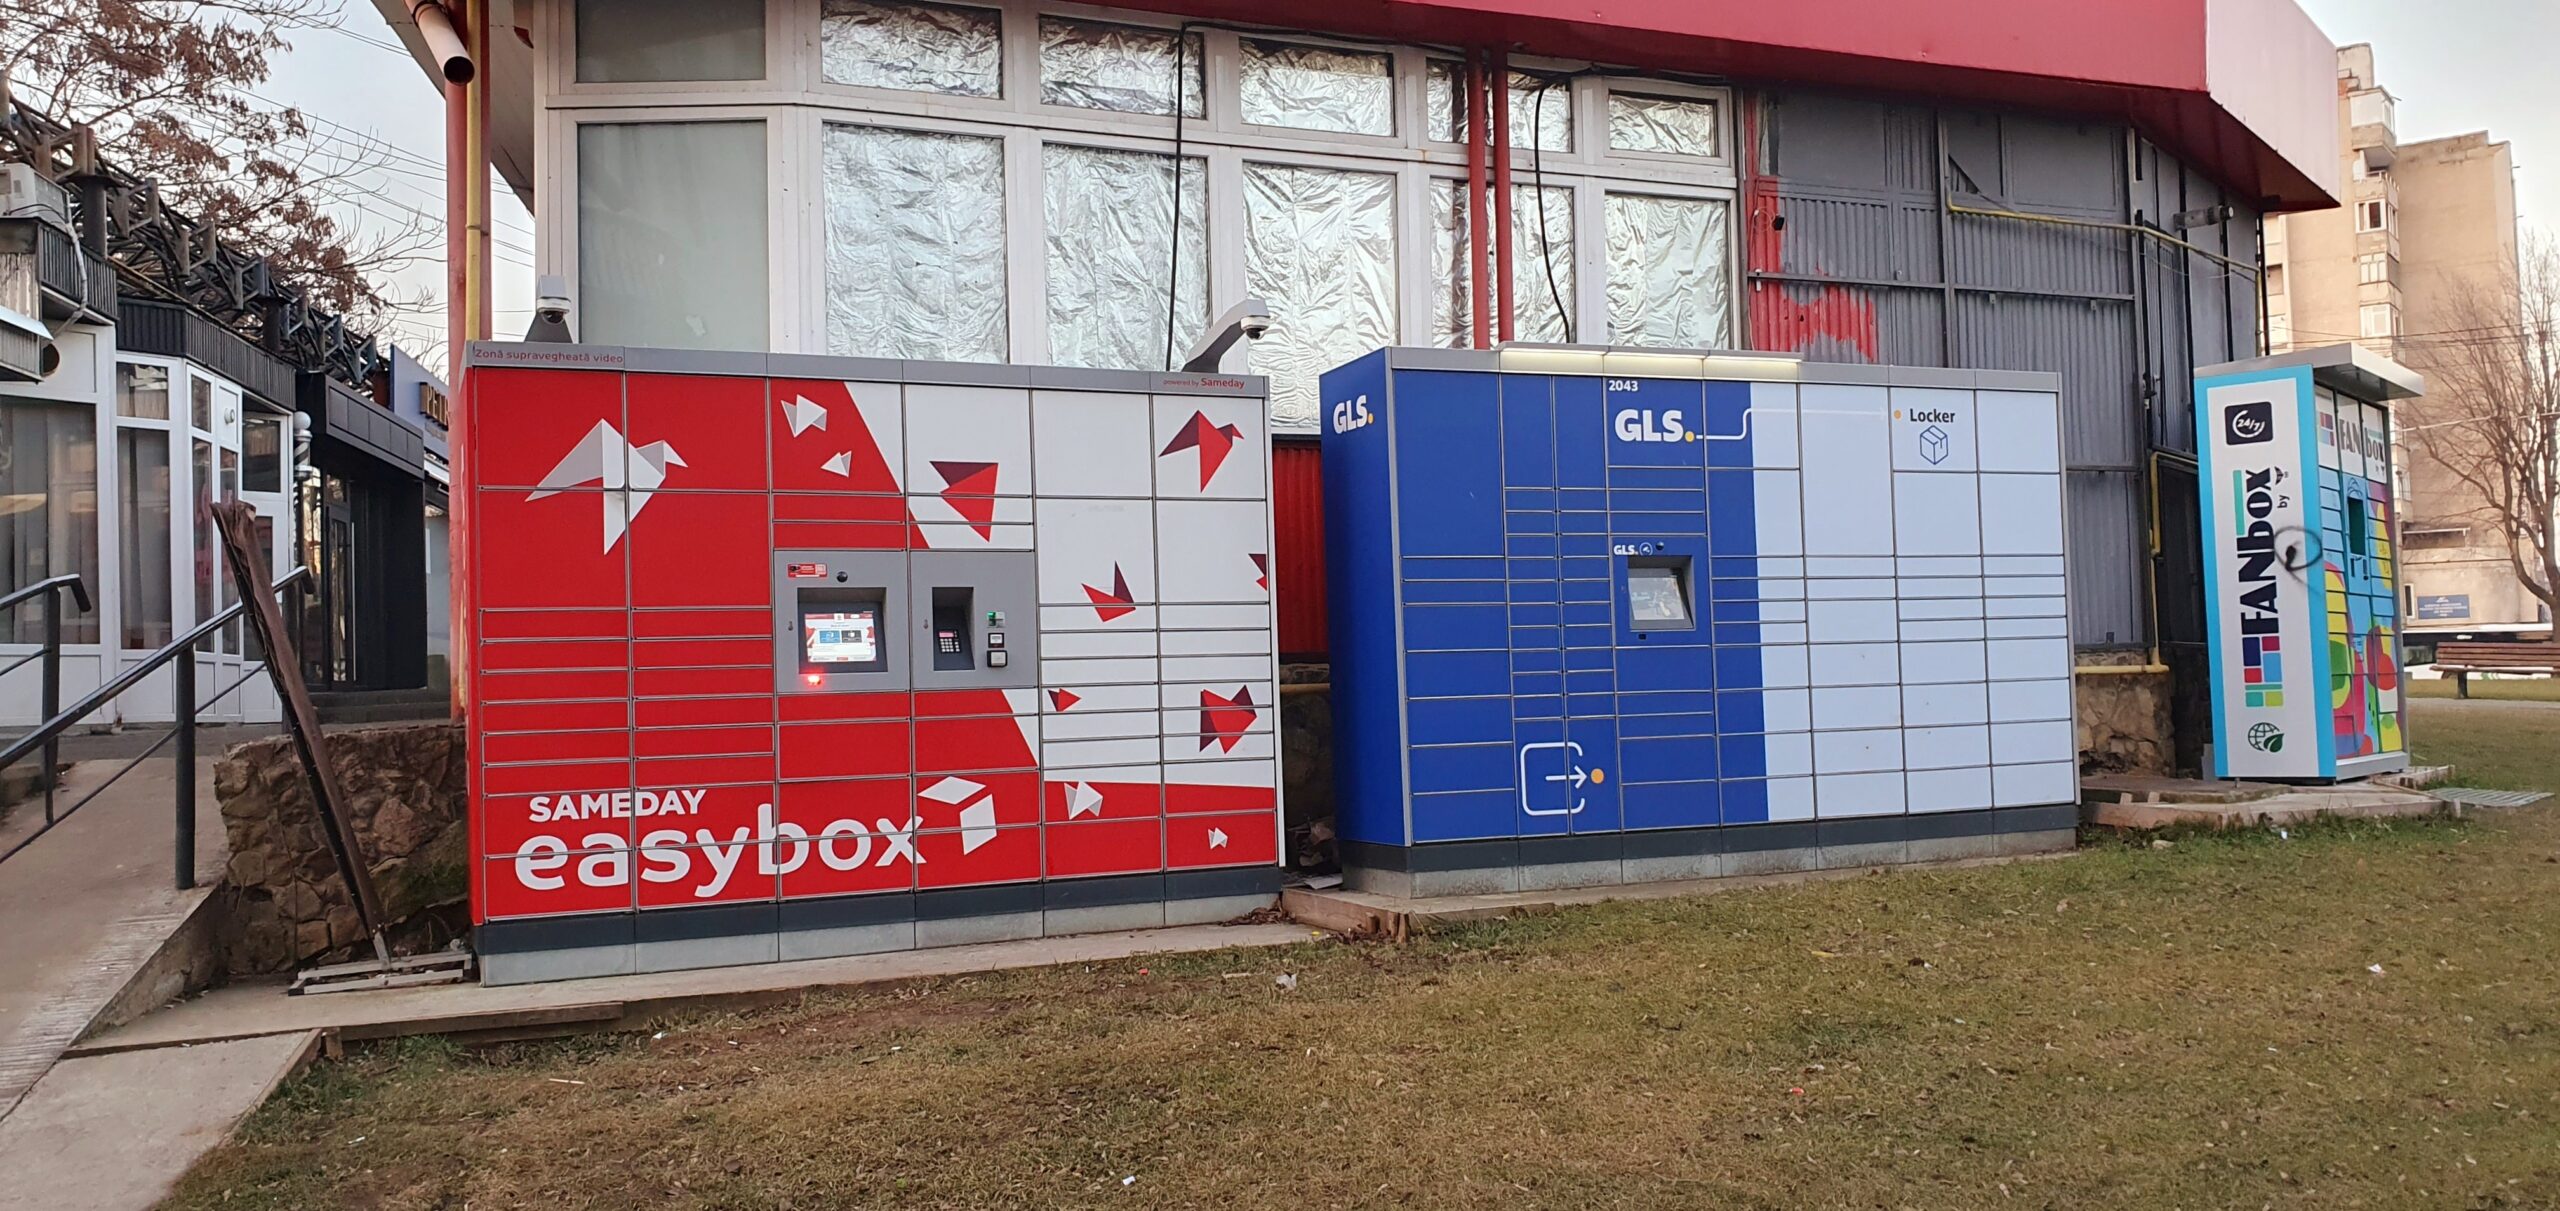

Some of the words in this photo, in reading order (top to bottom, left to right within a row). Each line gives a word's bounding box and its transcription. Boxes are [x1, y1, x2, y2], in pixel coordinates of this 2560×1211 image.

[593, 354, 624, 363] video
[1200, 377, 1245, 389] Sameday
[1608, 380, 1638, 391] 2043
[1909, 408, 1956, 423] Locker
[2237, 418, 2261, 431] 24/7
[2277, 494, 2290, 509] by
[2236, 467, 2280, 636] FANbox
[528, 789, 707, 823] SAMEDAY
[514, 803, 928, 898] easybox
